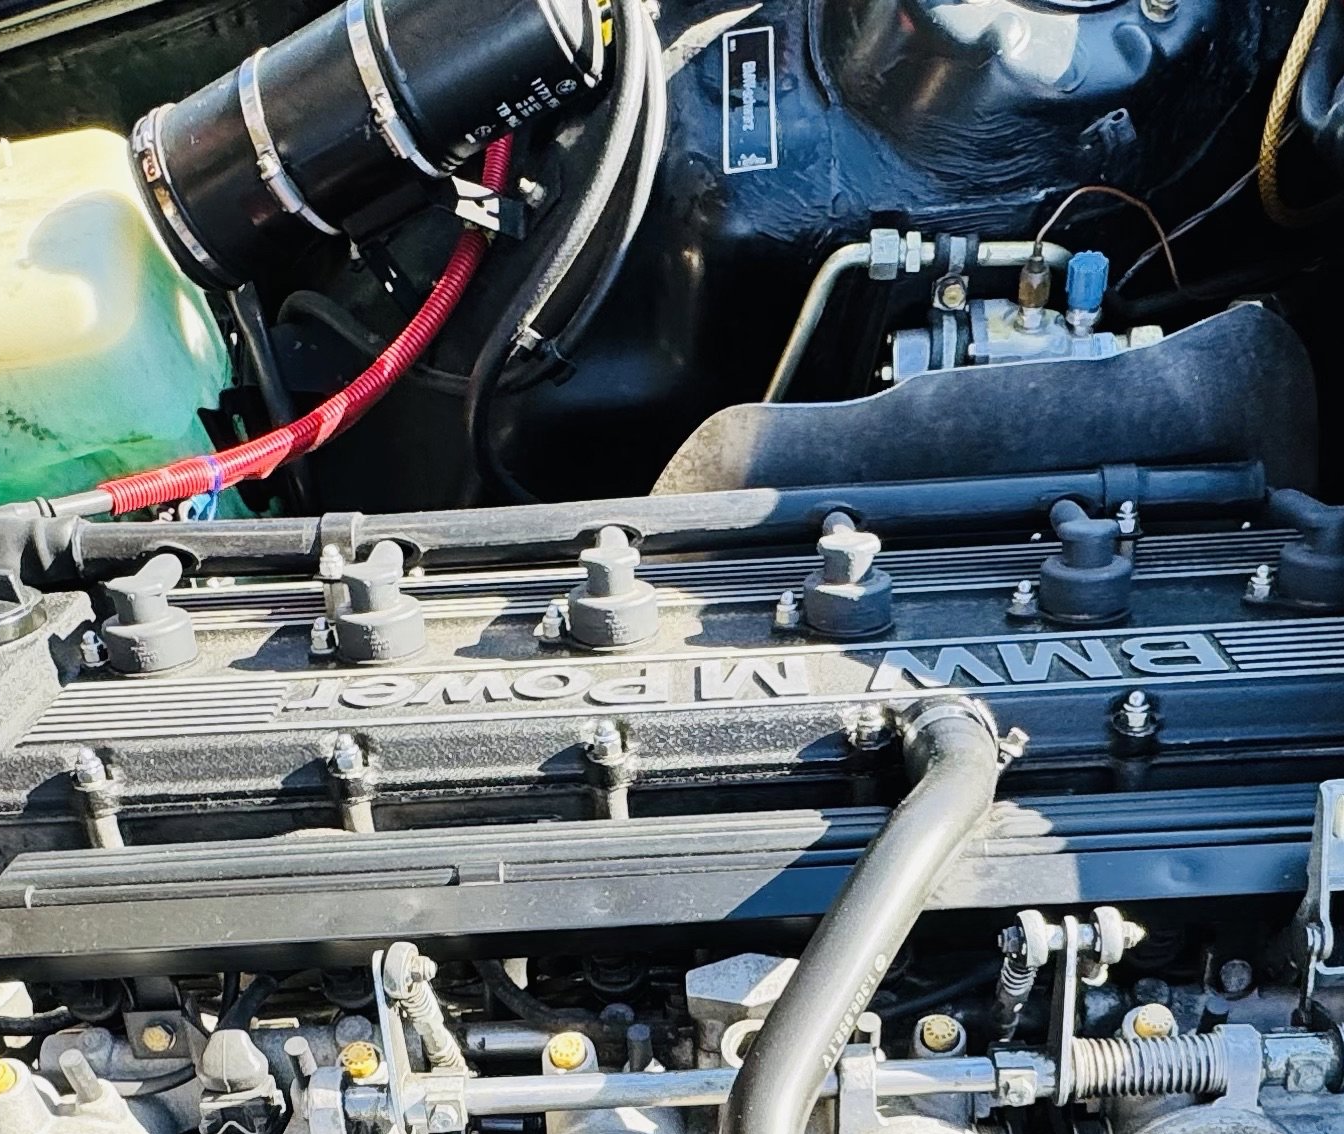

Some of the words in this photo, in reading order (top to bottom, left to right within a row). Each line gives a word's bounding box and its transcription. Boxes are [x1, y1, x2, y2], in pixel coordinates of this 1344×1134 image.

[693, 655, 812, 700] M
[869, 632, 1231, 691] BMW
[281, 666, 670, 711] Power
